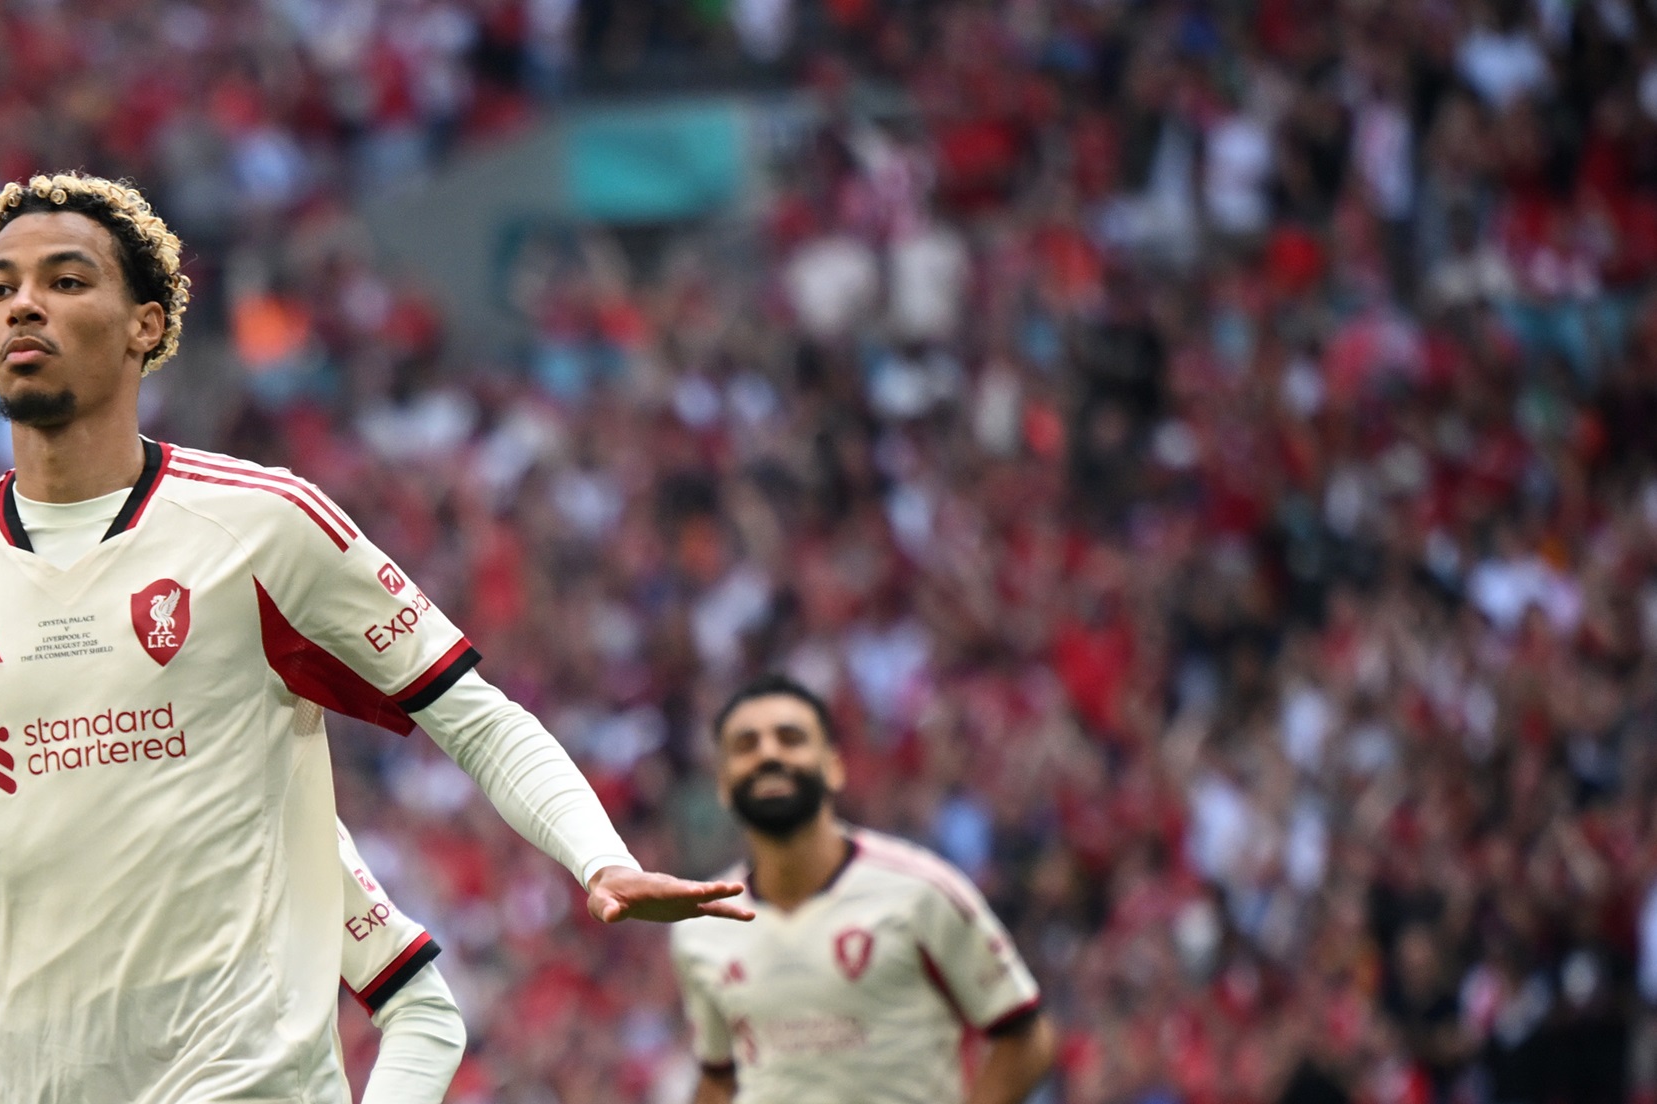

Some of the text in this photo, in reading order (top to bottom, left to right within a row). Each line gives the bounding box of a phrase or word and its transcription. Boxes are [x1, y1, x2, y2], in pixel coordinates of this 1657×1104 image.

[38, 615, 95, 627] CRYSTAL PALACE
[42, 633, 81, 643] LIVERPOOL
[52, 642, 80, 650] AUGUST
[82, 639, 98, 647] 2025
[44, 649, 88, 660] COMMUNITY
[89, 645, 114, 655] SHIELD
[23, 702, 174, 746] standard
[27, 730, 187, 775] chartered
[345, 902, 392, 942] Exp
